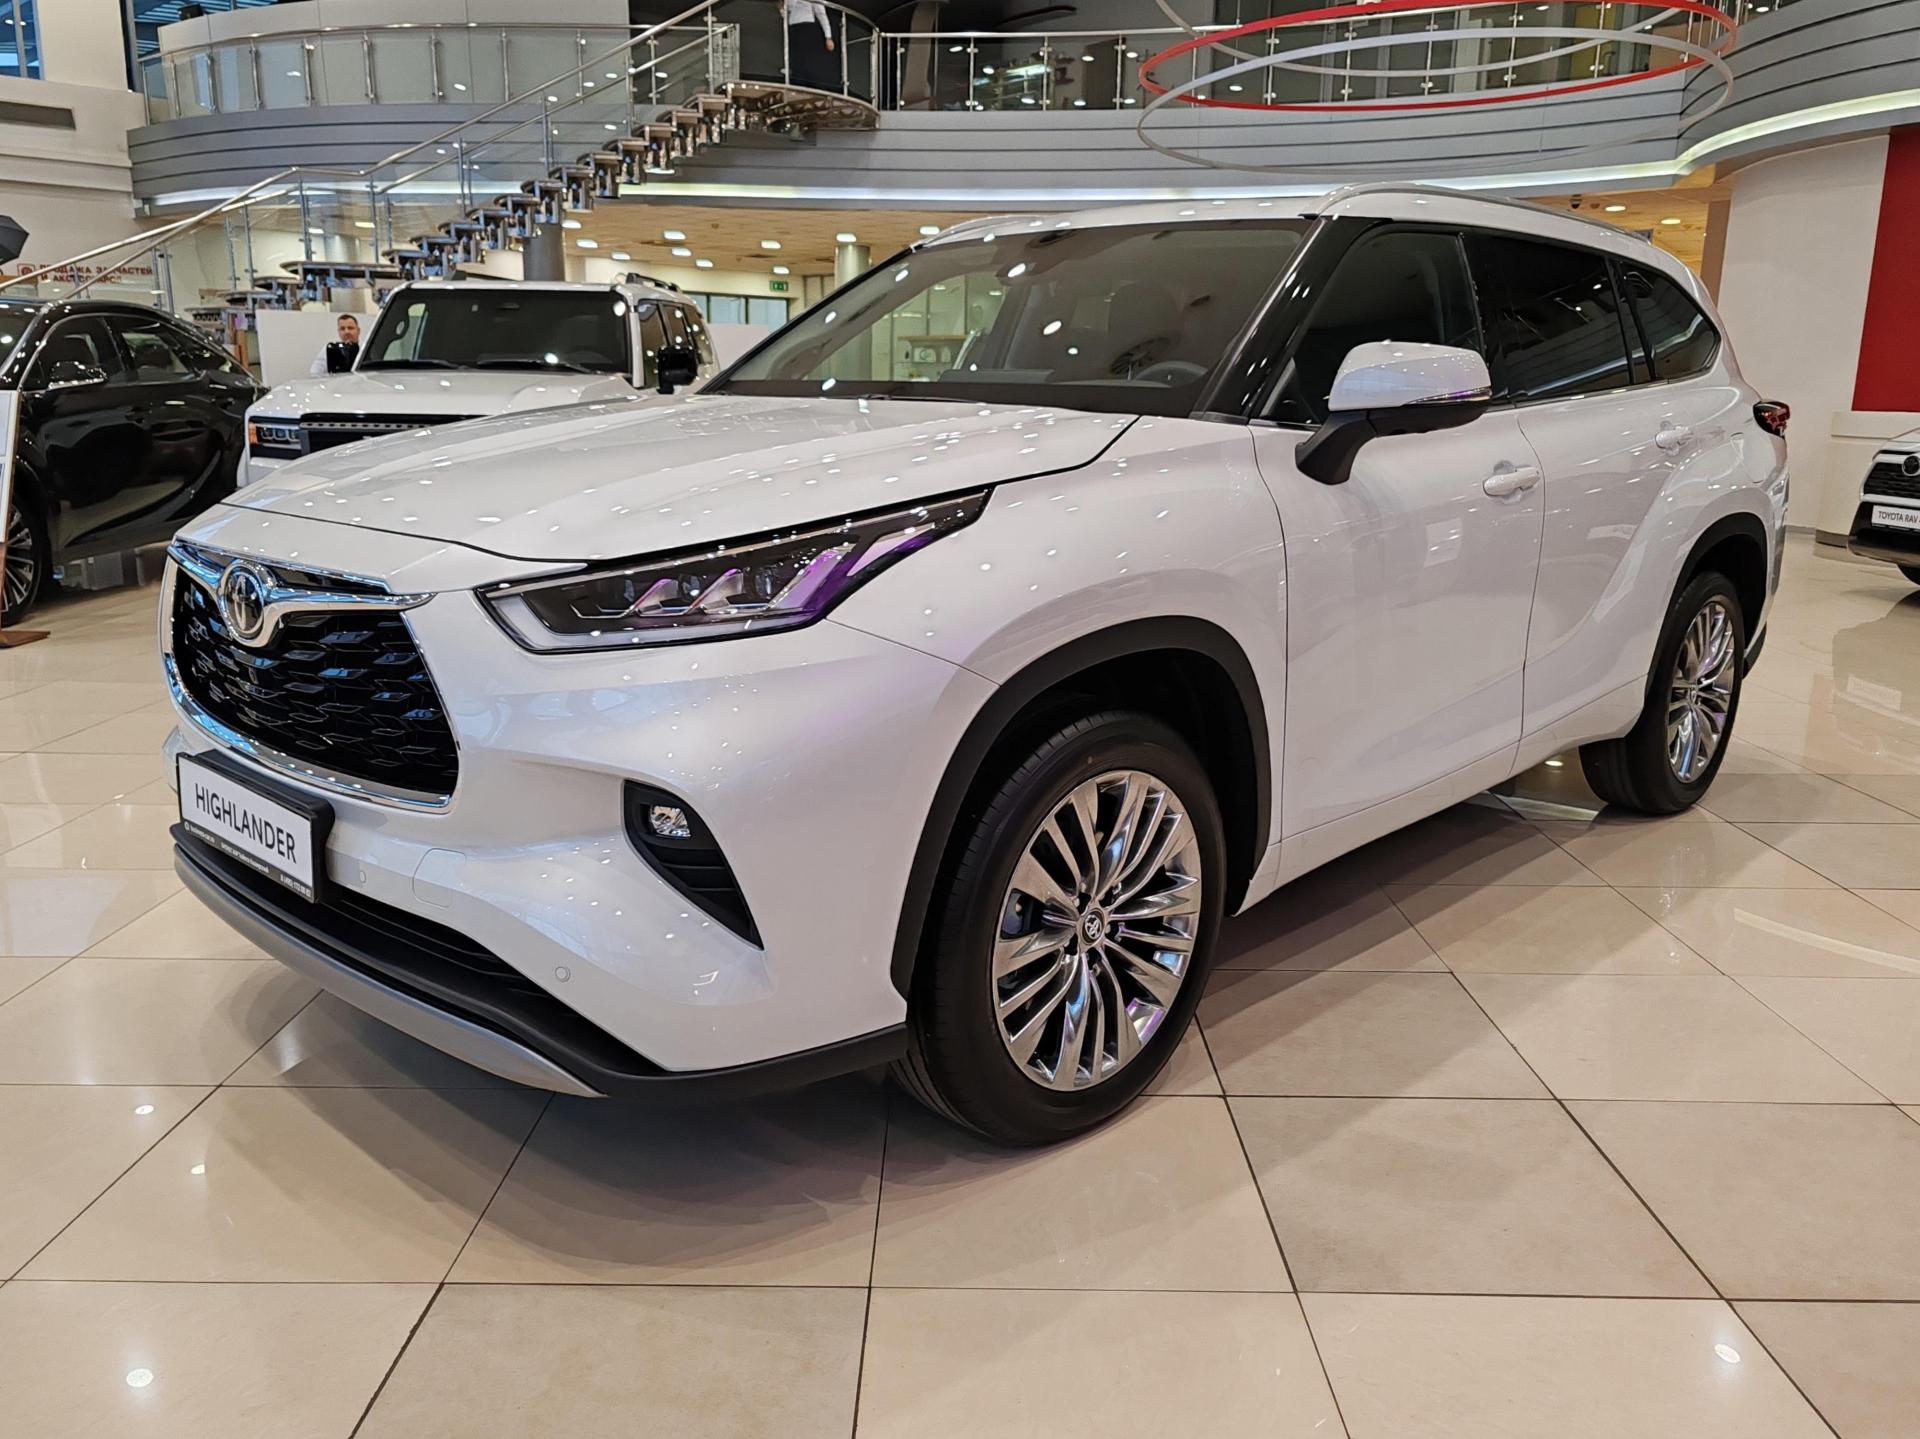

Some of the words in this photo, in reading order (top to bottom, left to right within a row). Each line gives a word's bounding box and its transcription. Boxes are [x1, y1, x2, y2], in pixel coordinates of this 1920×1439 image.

[1878, 511, 1903, 521] TOYOTA
[1905, 514, 1918, 524] RAV
[195, 783, 297, 864] HIGHLANDER
